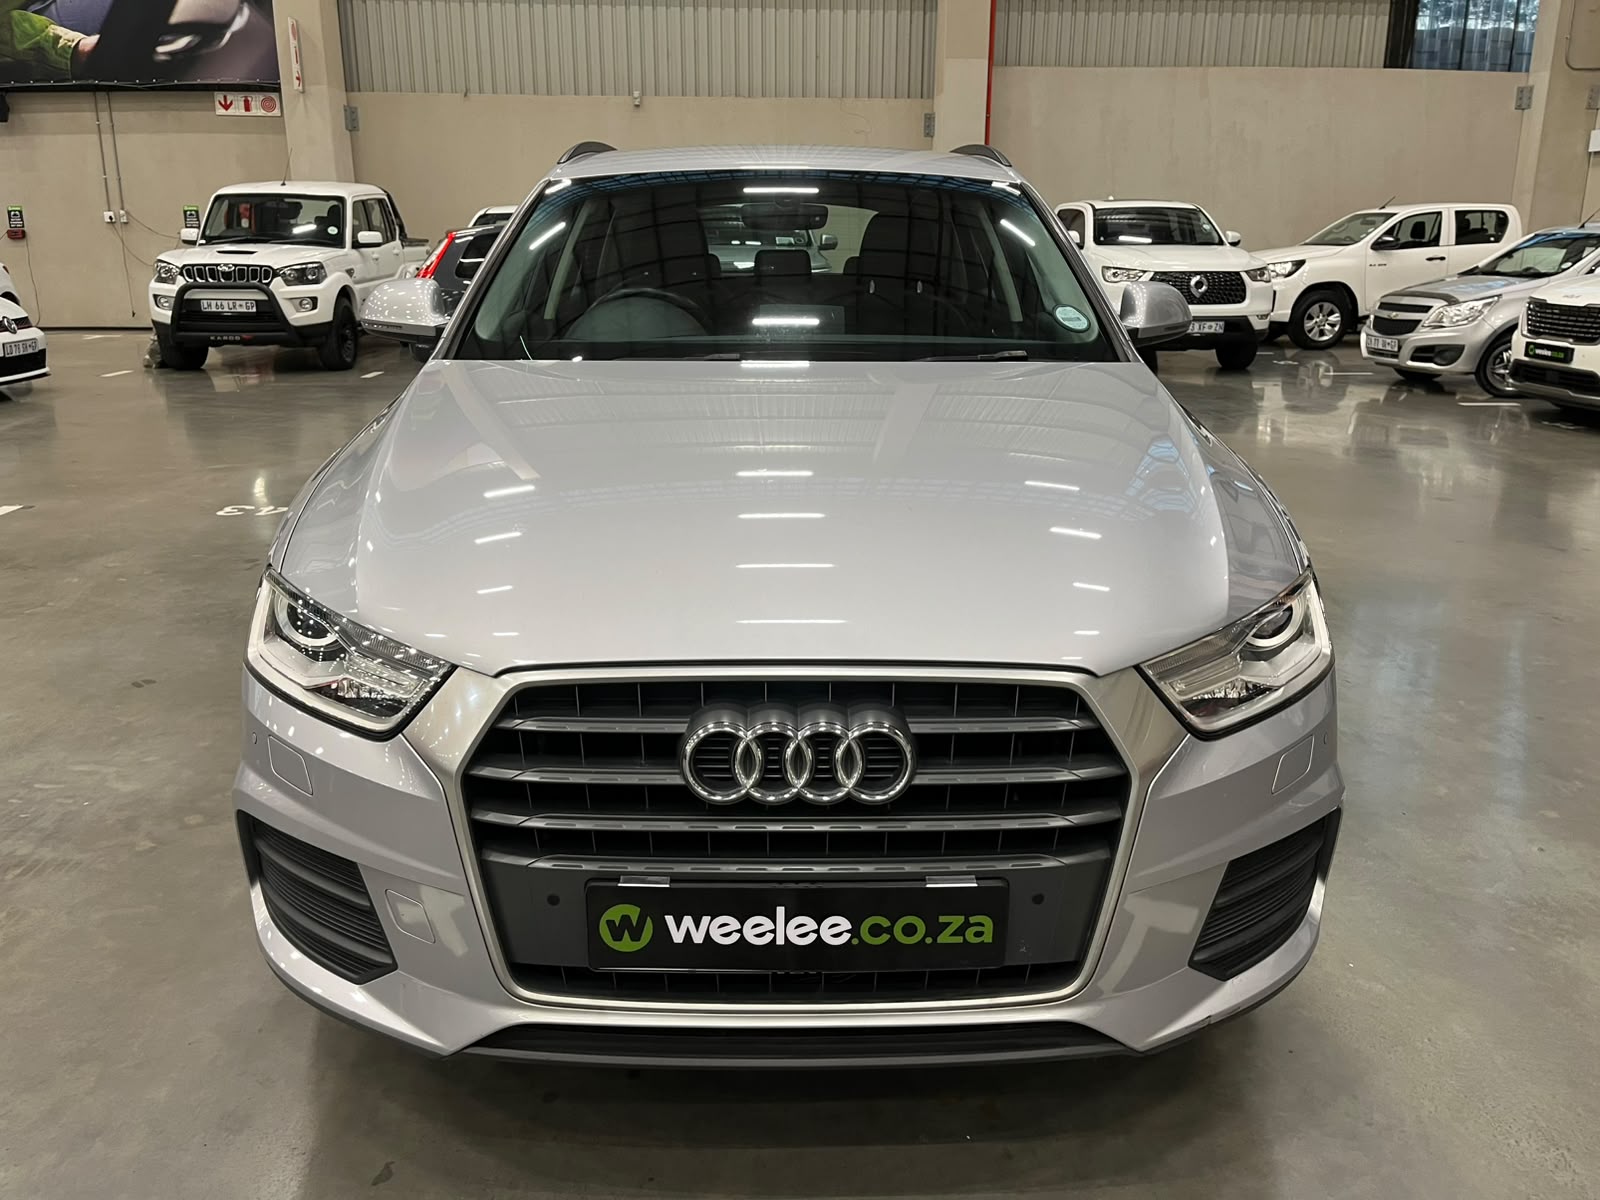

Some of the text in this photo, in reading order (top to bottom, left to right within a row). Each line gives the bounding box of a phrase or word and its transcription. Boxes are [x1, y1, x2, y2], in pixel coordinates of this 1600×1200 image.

[202, 301, 254, 310] LH 66 LR GP
[664, 905, 994, 946] weelee.co.za
